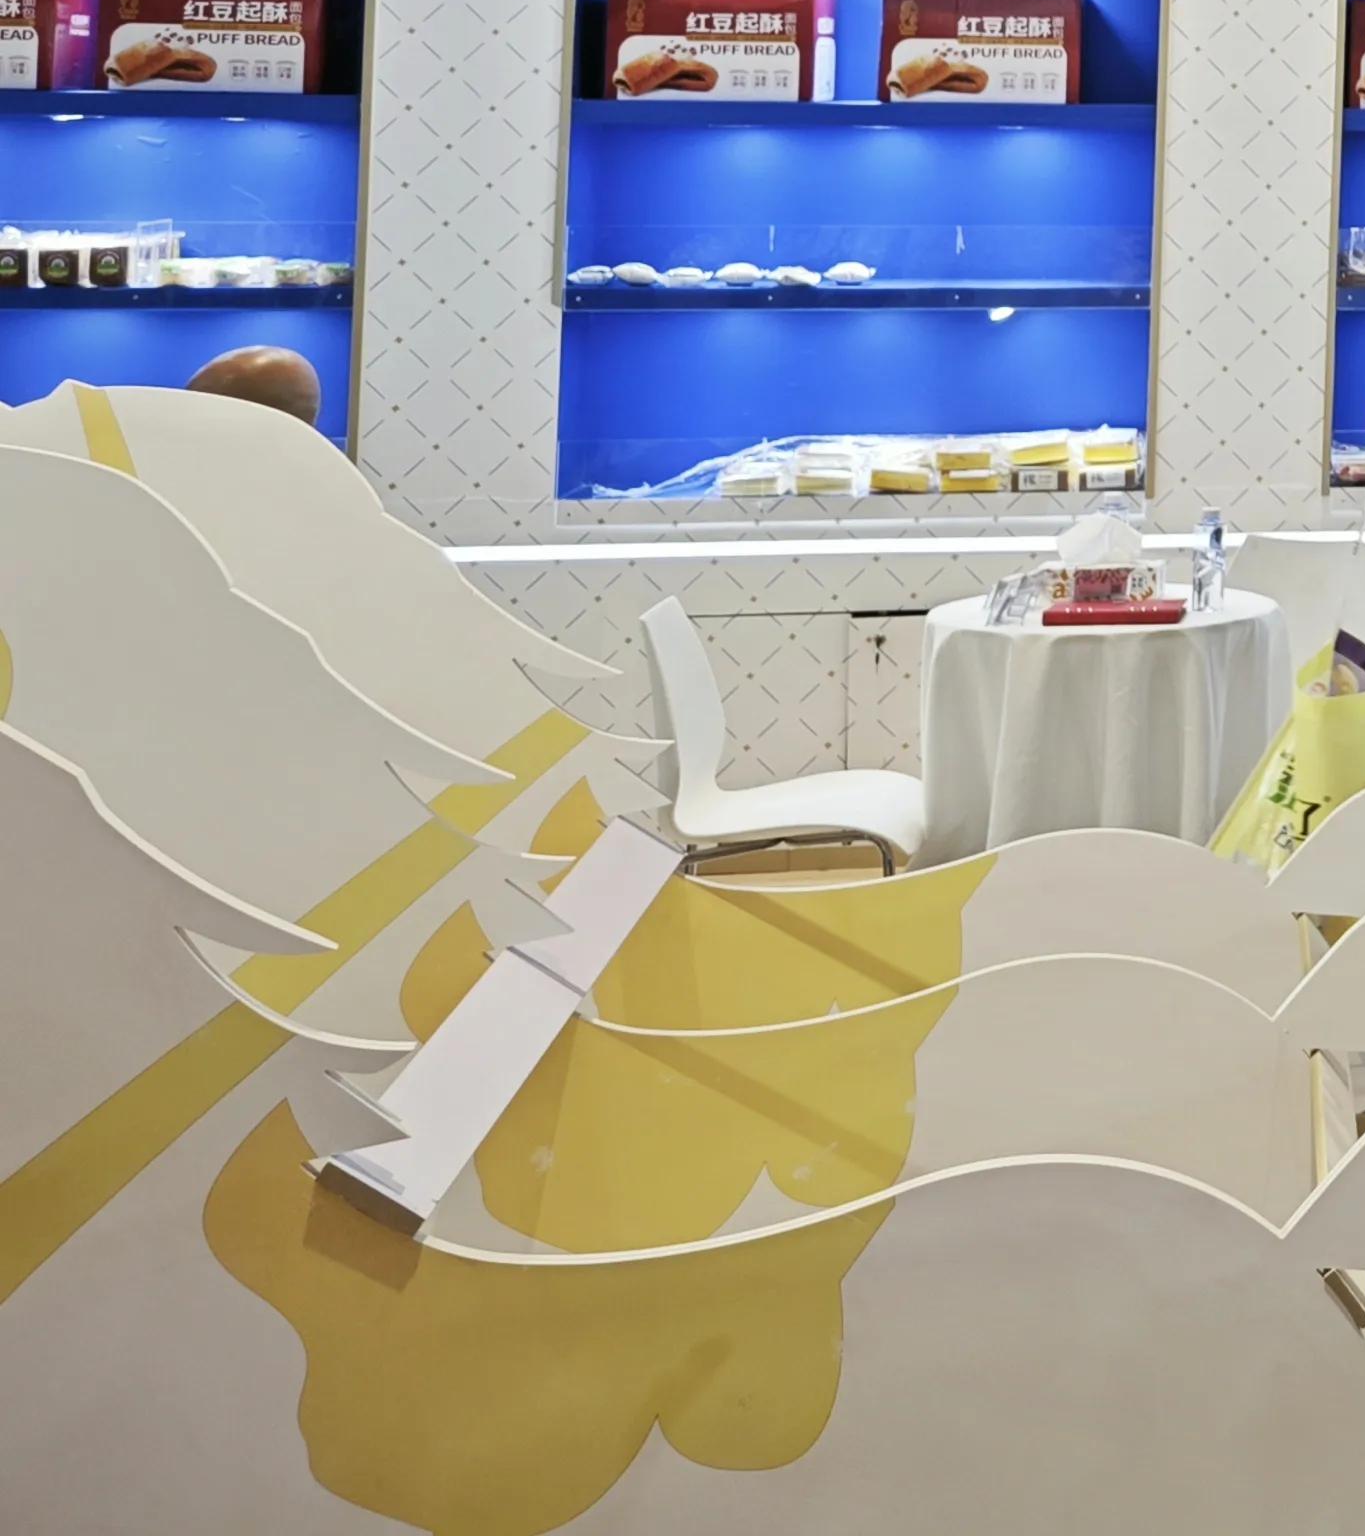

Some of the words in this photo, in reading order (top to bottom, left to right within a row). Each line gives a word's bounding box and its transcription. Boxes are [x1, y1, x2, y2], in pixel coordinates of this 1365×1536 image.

[183, 0, 288, 22] 红豆起酥
[686, 12, 784, 34] 红豆起酥
[957, 16, 1052, 38] 红豆起酥
[197, 33, 240, 45] PUFF
[244, 34, 301, 46] BREAD
[700, 45, 740, 56] PUFF
[744, 45, 795, 56] BREAD
[971, 48, 1010, 59] PUFF
[1013, 48, 1063, 59] BREAD
